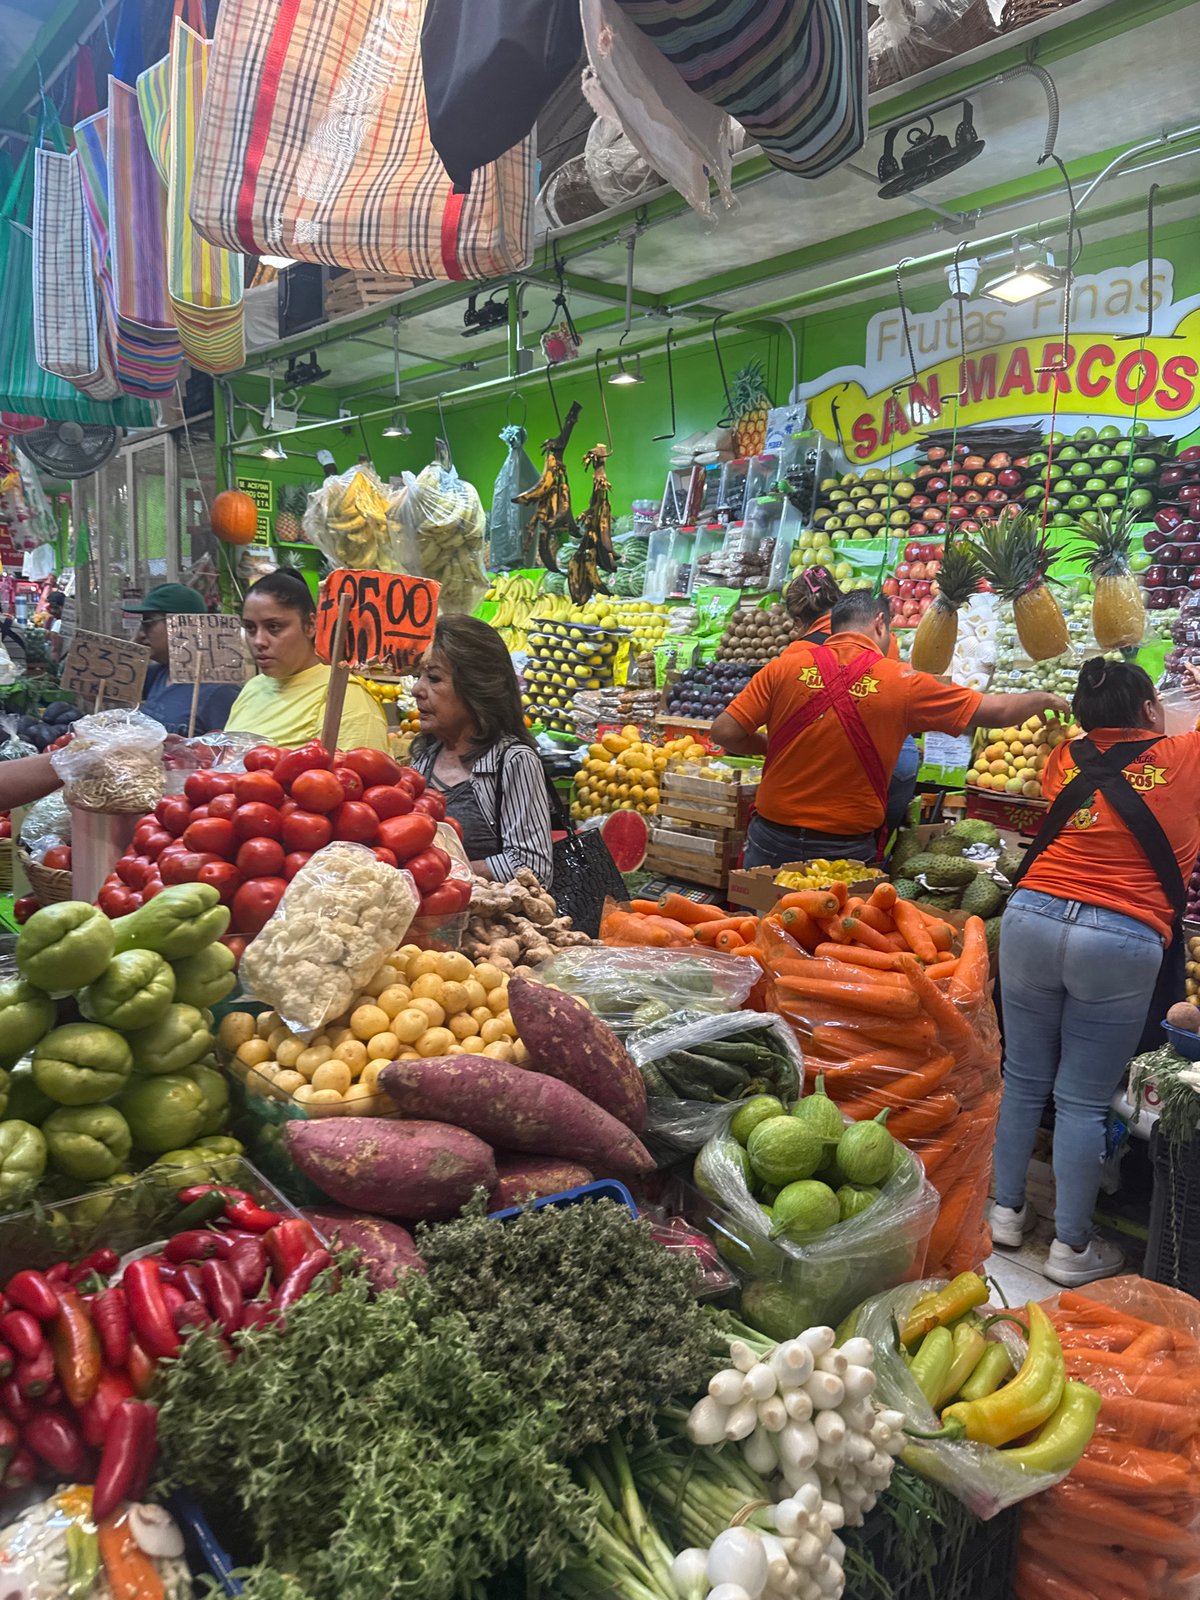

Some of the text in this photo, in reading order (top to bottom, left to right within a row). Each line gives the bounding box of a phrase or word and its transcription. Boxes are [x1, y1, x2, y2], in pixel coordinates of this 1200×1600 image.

[877, 273, 1166, 362] Frutas Finas
[851, 342, 1199, 459] SAN MARCOS
[71, 640, 137, 686] $35
[172, 631, 244, 669] $45
[89, 682, 120, 697] KLO
[1126, 773, 1153, 788] COS
